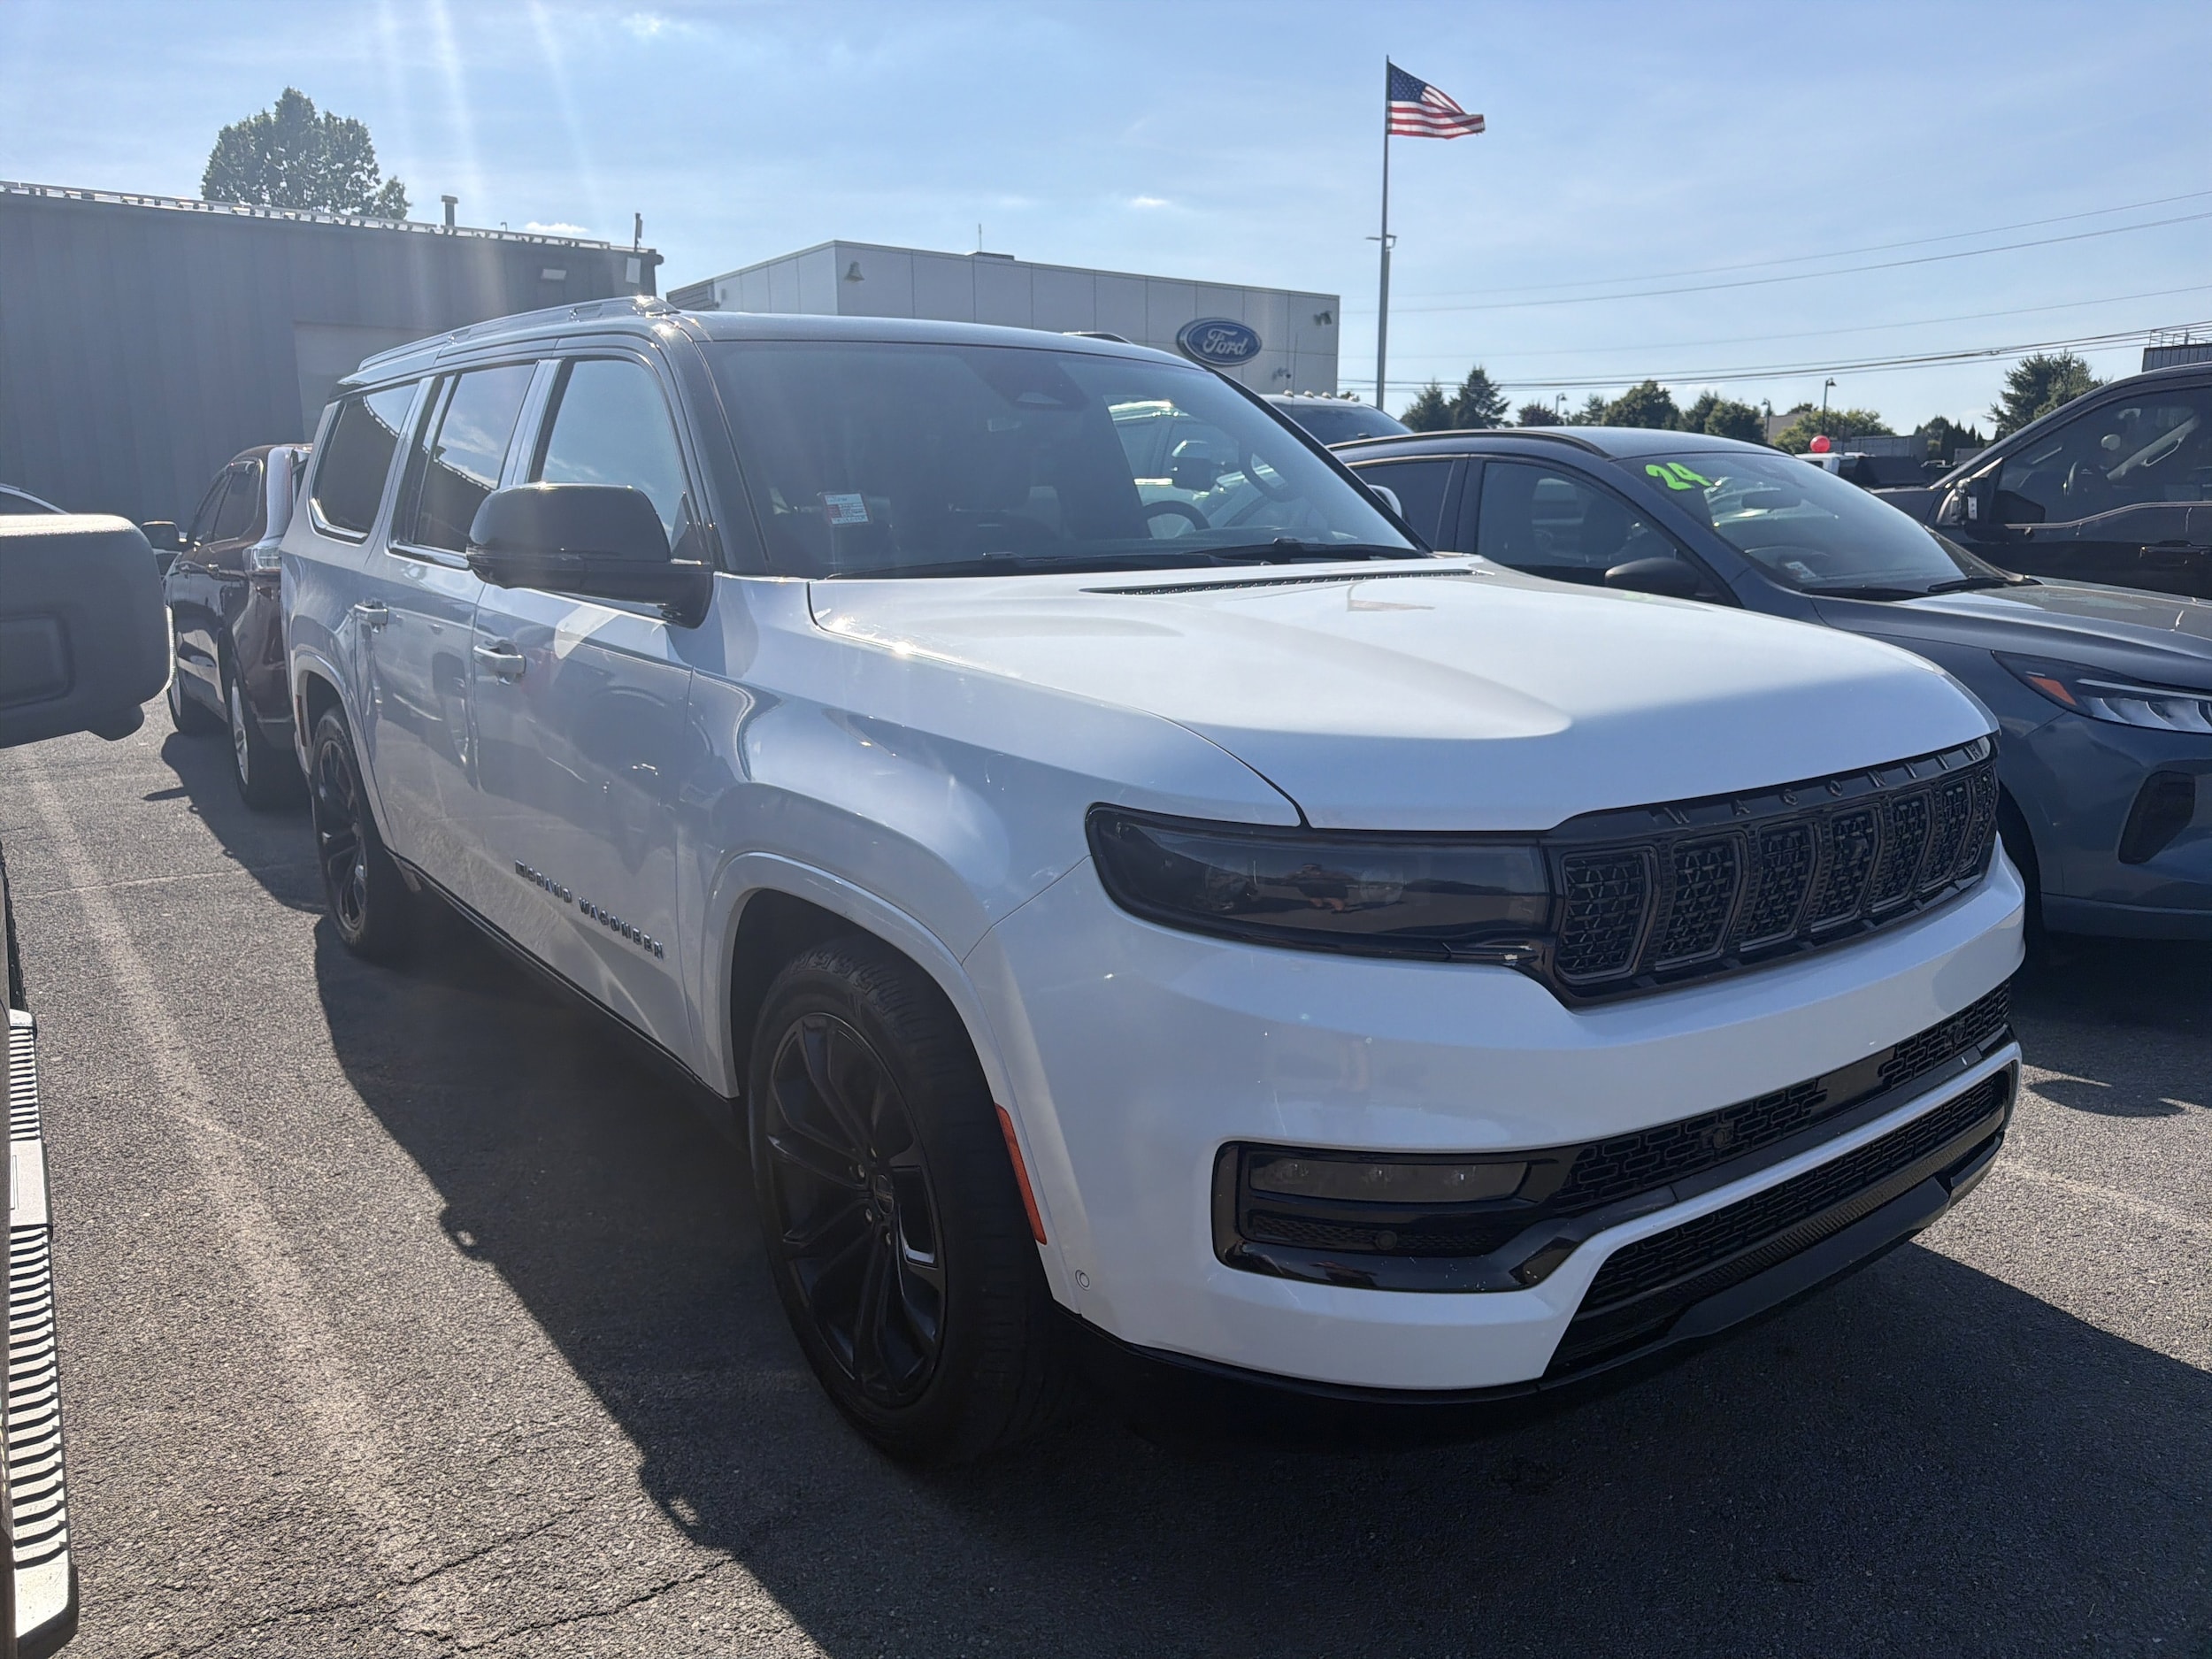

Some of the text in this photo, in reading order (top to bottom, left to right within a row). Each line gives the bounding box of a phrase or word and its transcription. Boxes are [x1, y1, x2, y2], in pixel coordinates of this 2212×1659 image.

[1202, 327, 1248, 356] Ford
[1645, 462, 1713, 491] 24
[527, 866, 664, 959] GRAND WAGONEER
